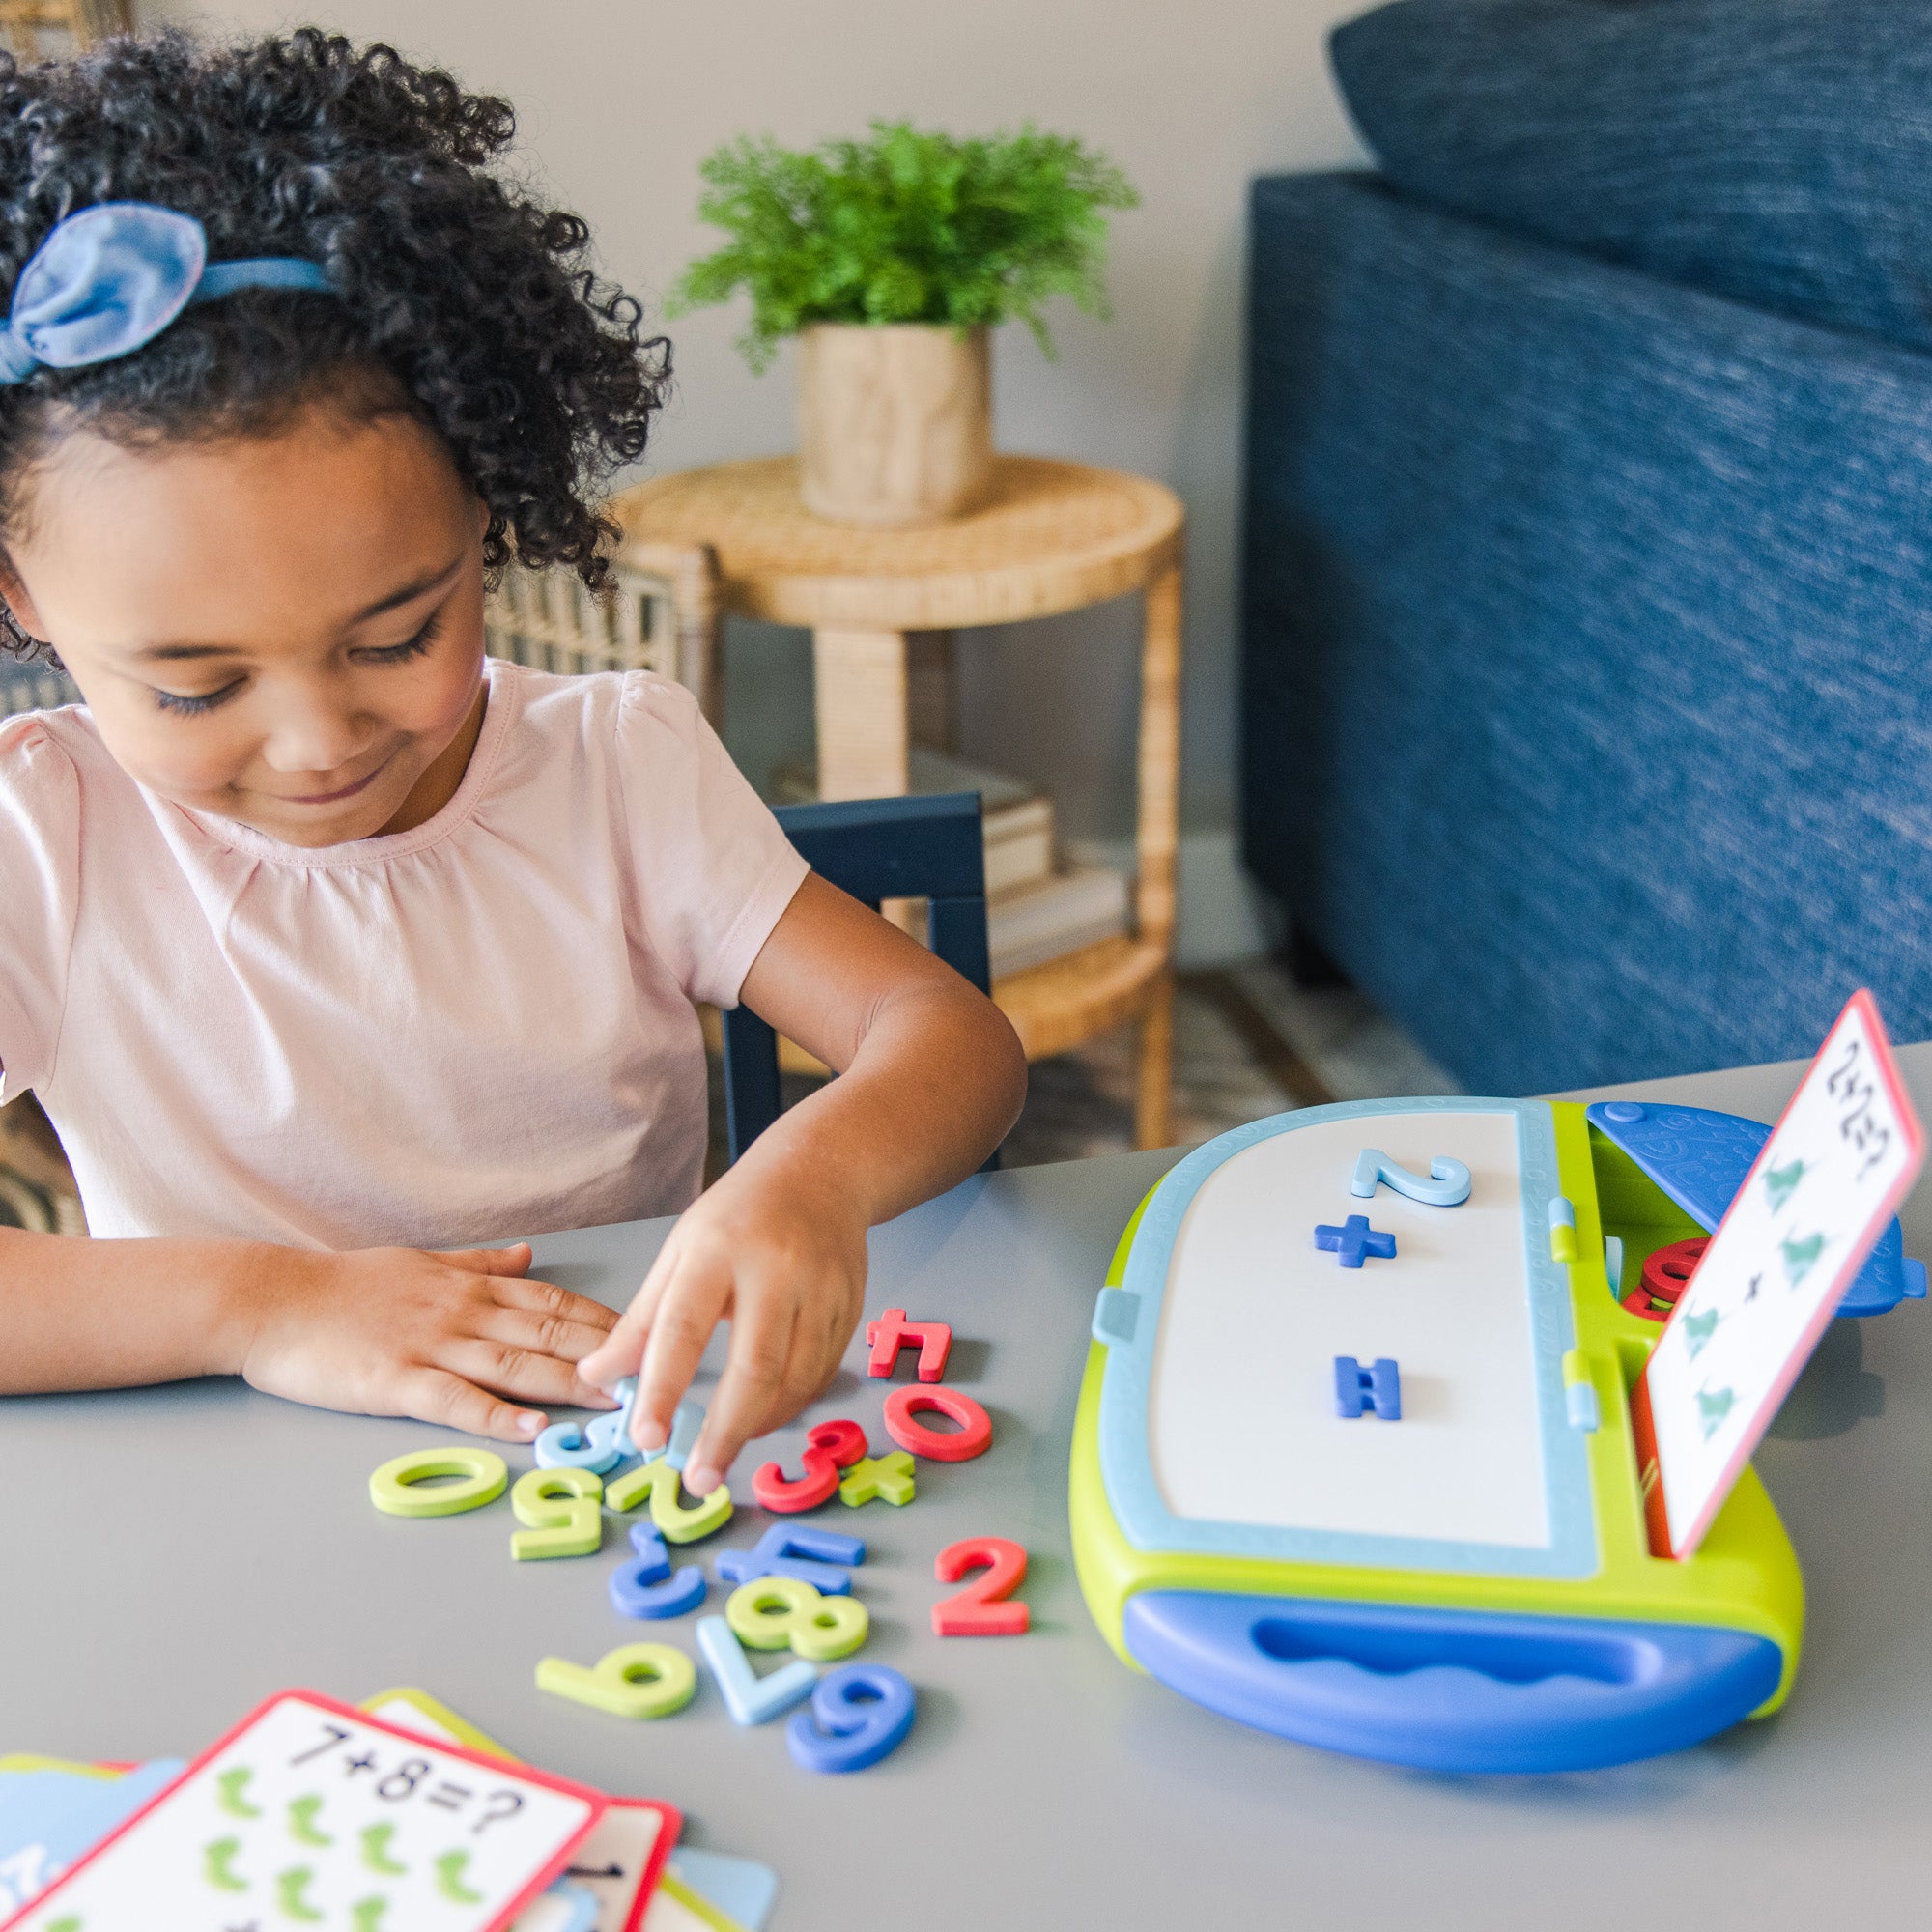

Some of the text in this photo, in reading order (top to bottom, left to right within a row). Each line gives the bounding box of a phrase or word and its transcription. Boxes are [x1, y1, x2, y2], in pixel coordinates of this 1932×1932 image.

[1351, 1149, 1472, 1208] 2
[752, 1419, 868, 1514] 3
[725, 1577, 869, 1662] 8
[931, 1535, 1030, 1636] 2
